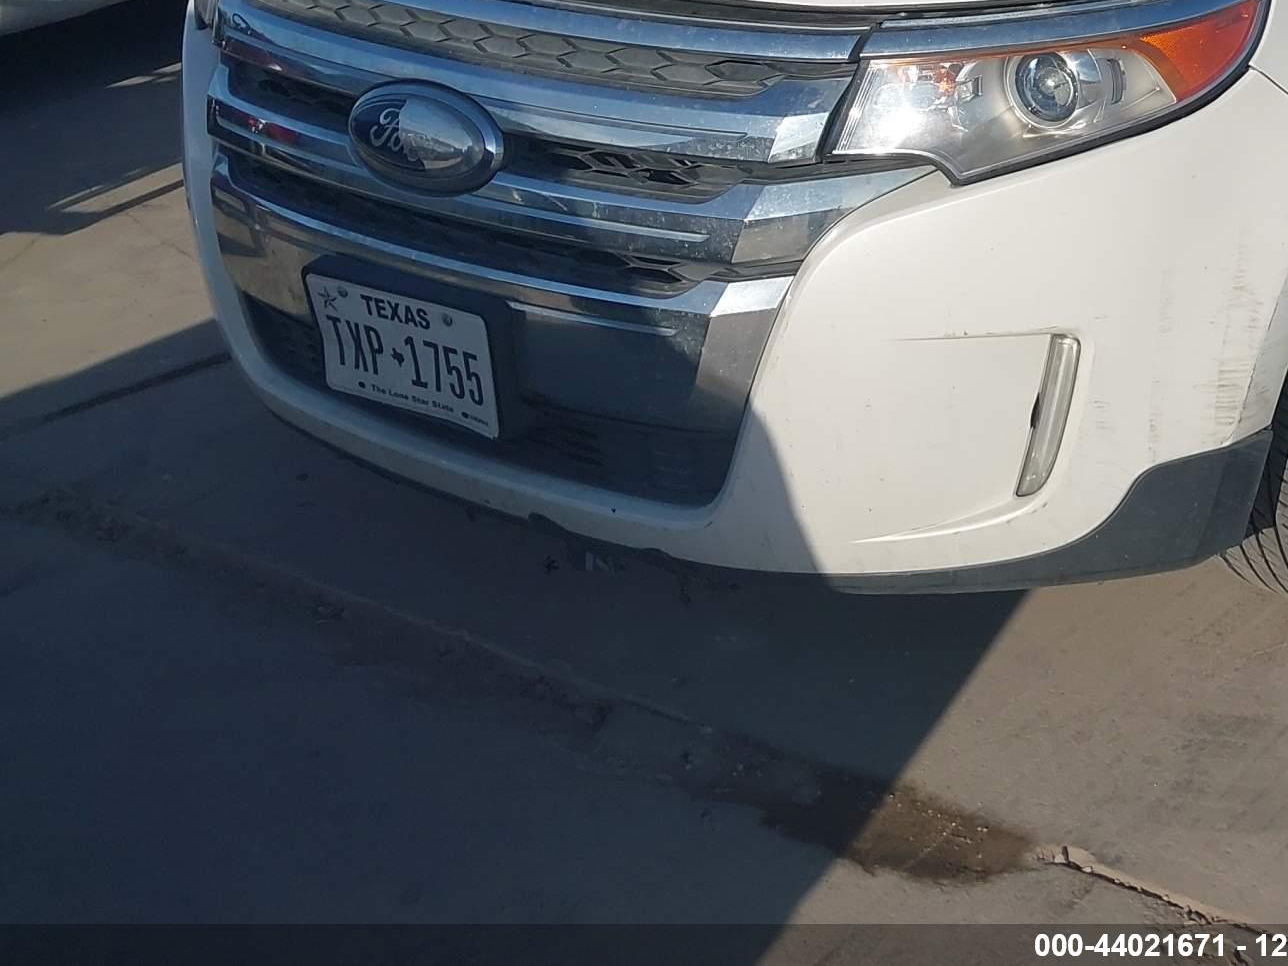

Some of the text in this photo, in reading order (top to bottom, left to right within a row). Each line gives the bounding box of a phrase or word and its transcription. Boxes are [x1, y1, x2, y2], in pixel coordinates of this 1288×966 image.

[360, 293, 431, 330] TEXAS
[326, 314, 484, 406] TXP 1755
[371, 384, 454, 413] The Lone Star State
